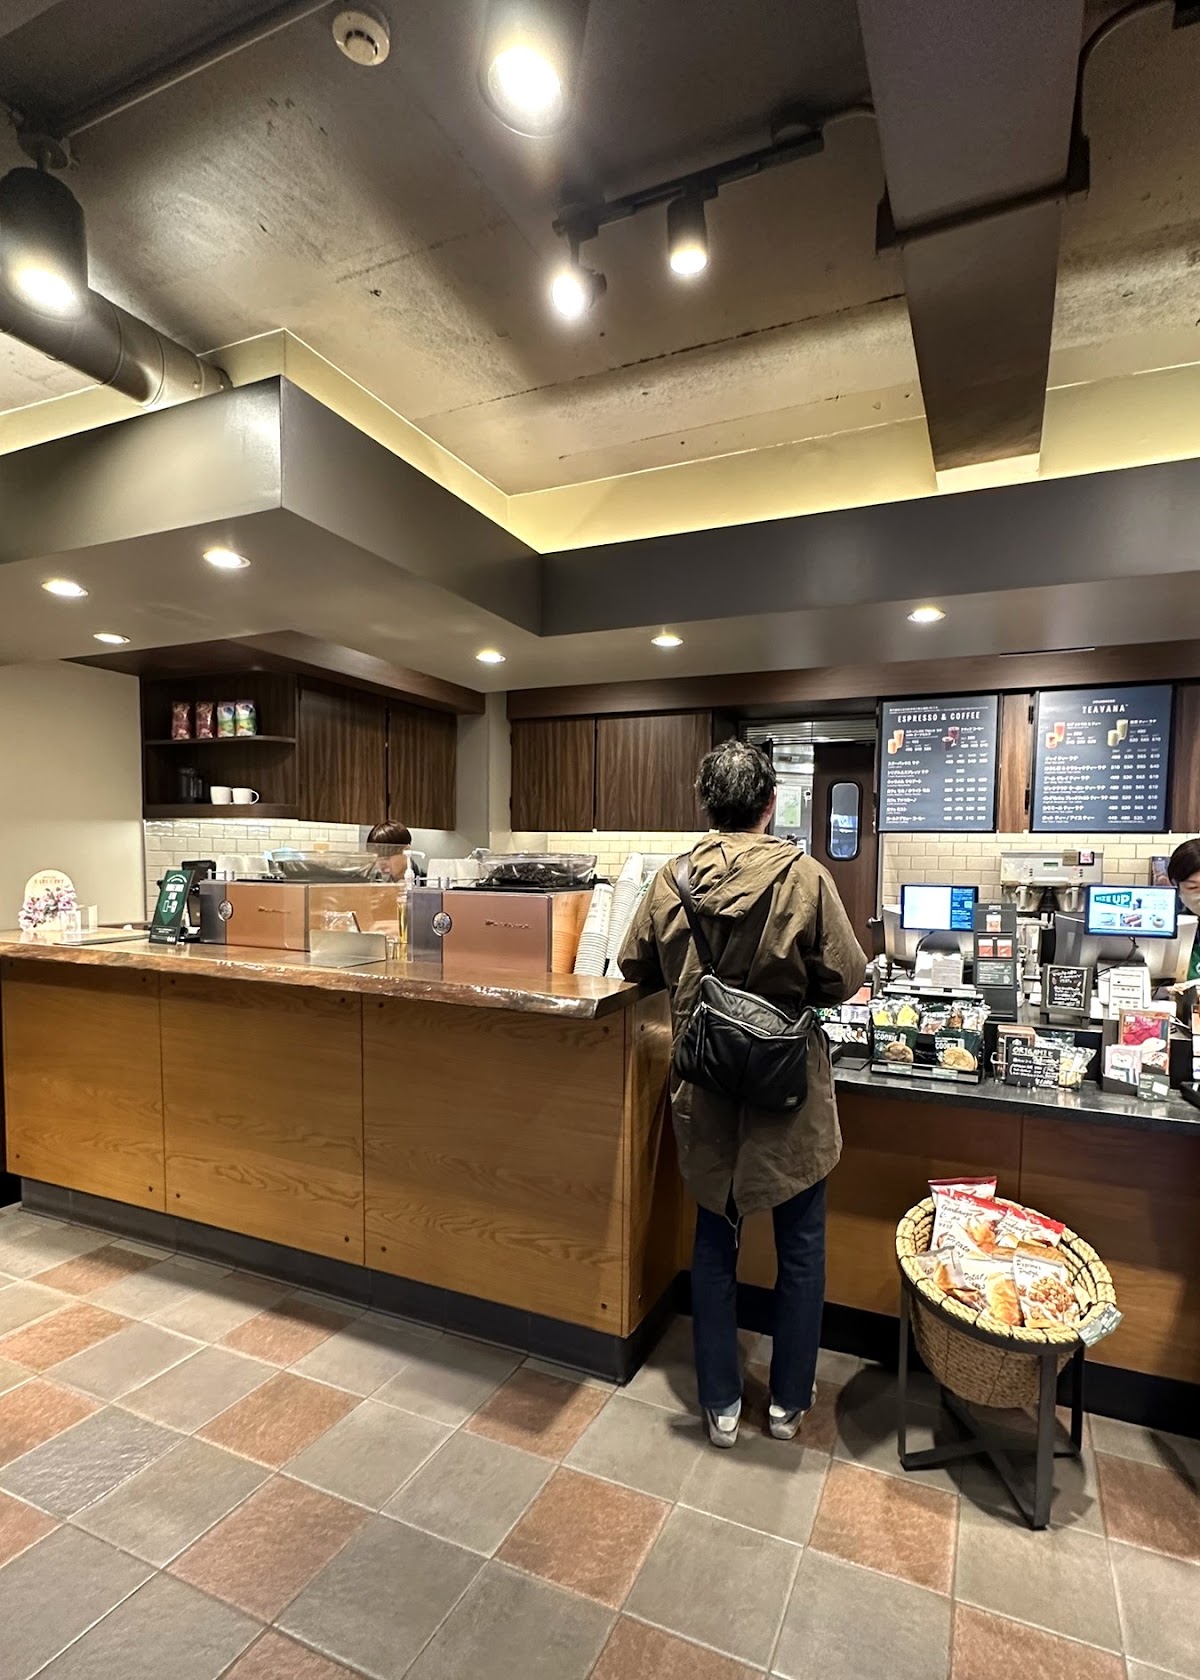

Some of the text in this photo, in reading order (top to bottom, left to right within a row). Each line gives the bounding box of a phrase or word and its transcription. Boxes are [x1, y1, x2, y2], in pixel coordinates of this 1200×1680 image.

[1082, 705, 1125, 714] TEAVANA
[898, 714, 938, 723] ESPRESSO
[950, 712, 980, 720] COFFEE
[1112, 894, 1130, 905] UP
